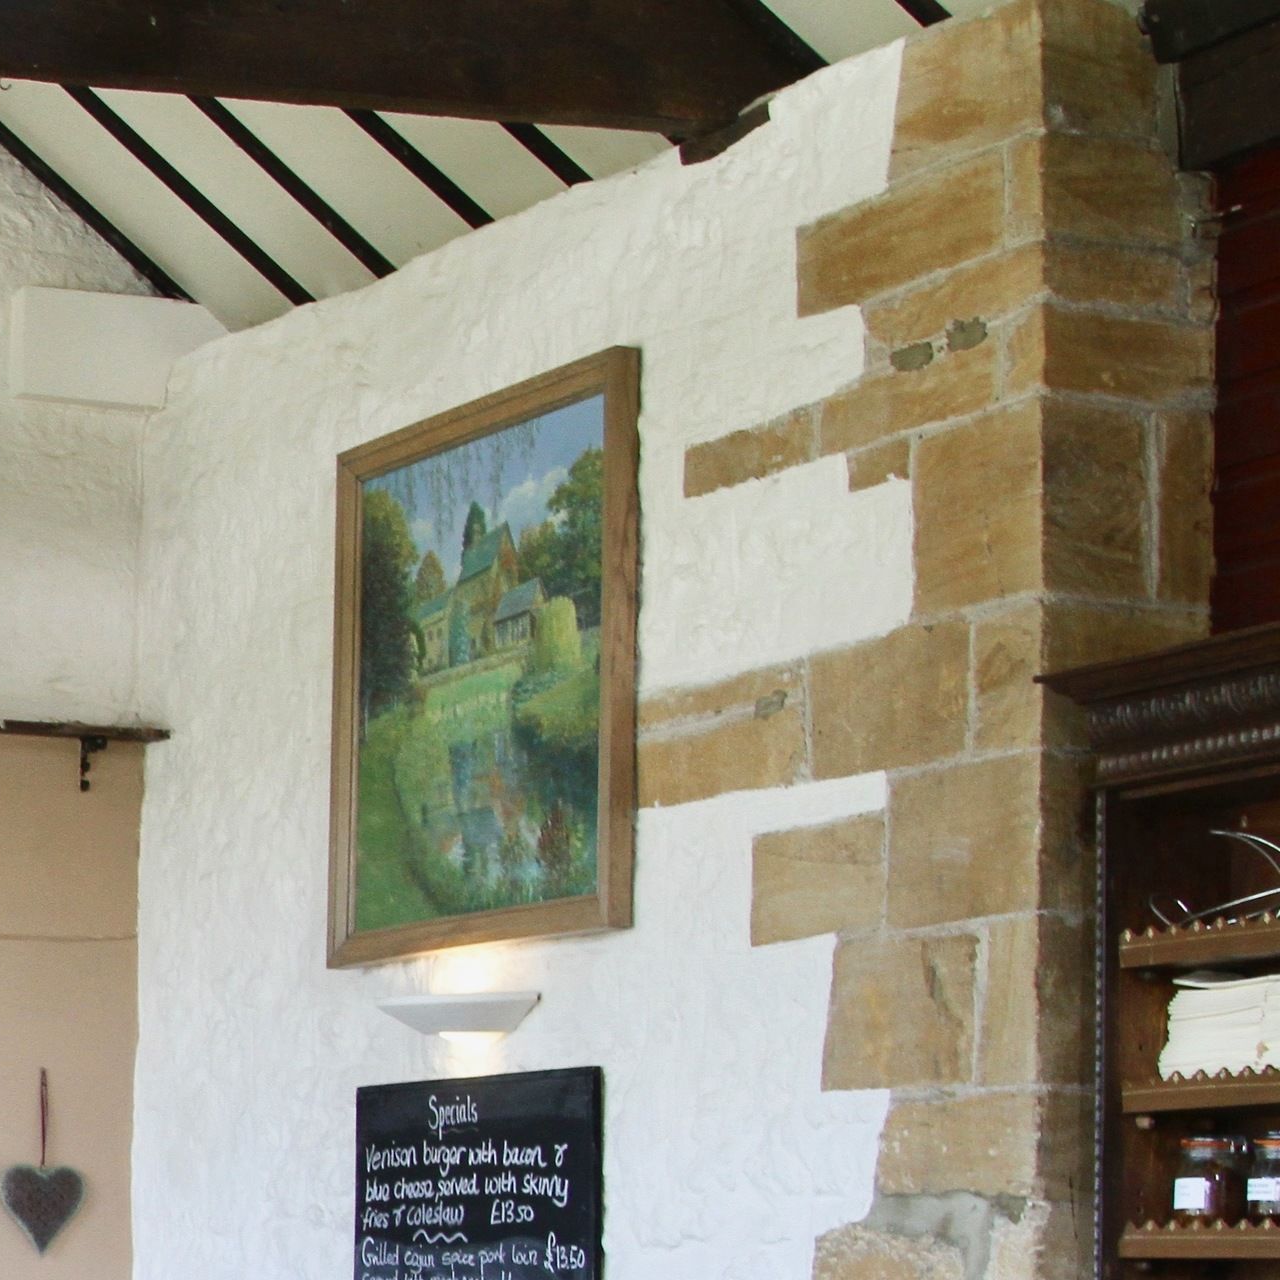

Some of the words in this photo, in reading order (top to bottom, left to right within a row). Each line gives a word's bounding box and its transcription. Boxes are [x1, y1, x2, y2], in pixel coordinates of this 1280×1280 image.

[428, 1094, 478, 1140] Specials
[365, 1140, 418, 1173] Venison
[423, 1139, 467, 1177] burger
[468, 1138, 497, 1166] with
[502, 1139, 548, 1168] bacon
[365, 1177, 390, 1203] blue
[437, 1172, 480, 1197] served
[484, 1170, 517, 1195] with
[521, 1171, 569, 1208] skinny
[362, 1206, 390, 1231] fries
[406, 1200, 465, 1226] coleslaw
[362, 1236, 400, 1268] Grilled
[404, 1244, 435, 1275] cajun
[441, 1249, 476, 1279] spice
[478, 1242, 506, 1277] pork
[512, 1244, 538, 1266] loin
[543, 1231, 586, 1274] £13.50
